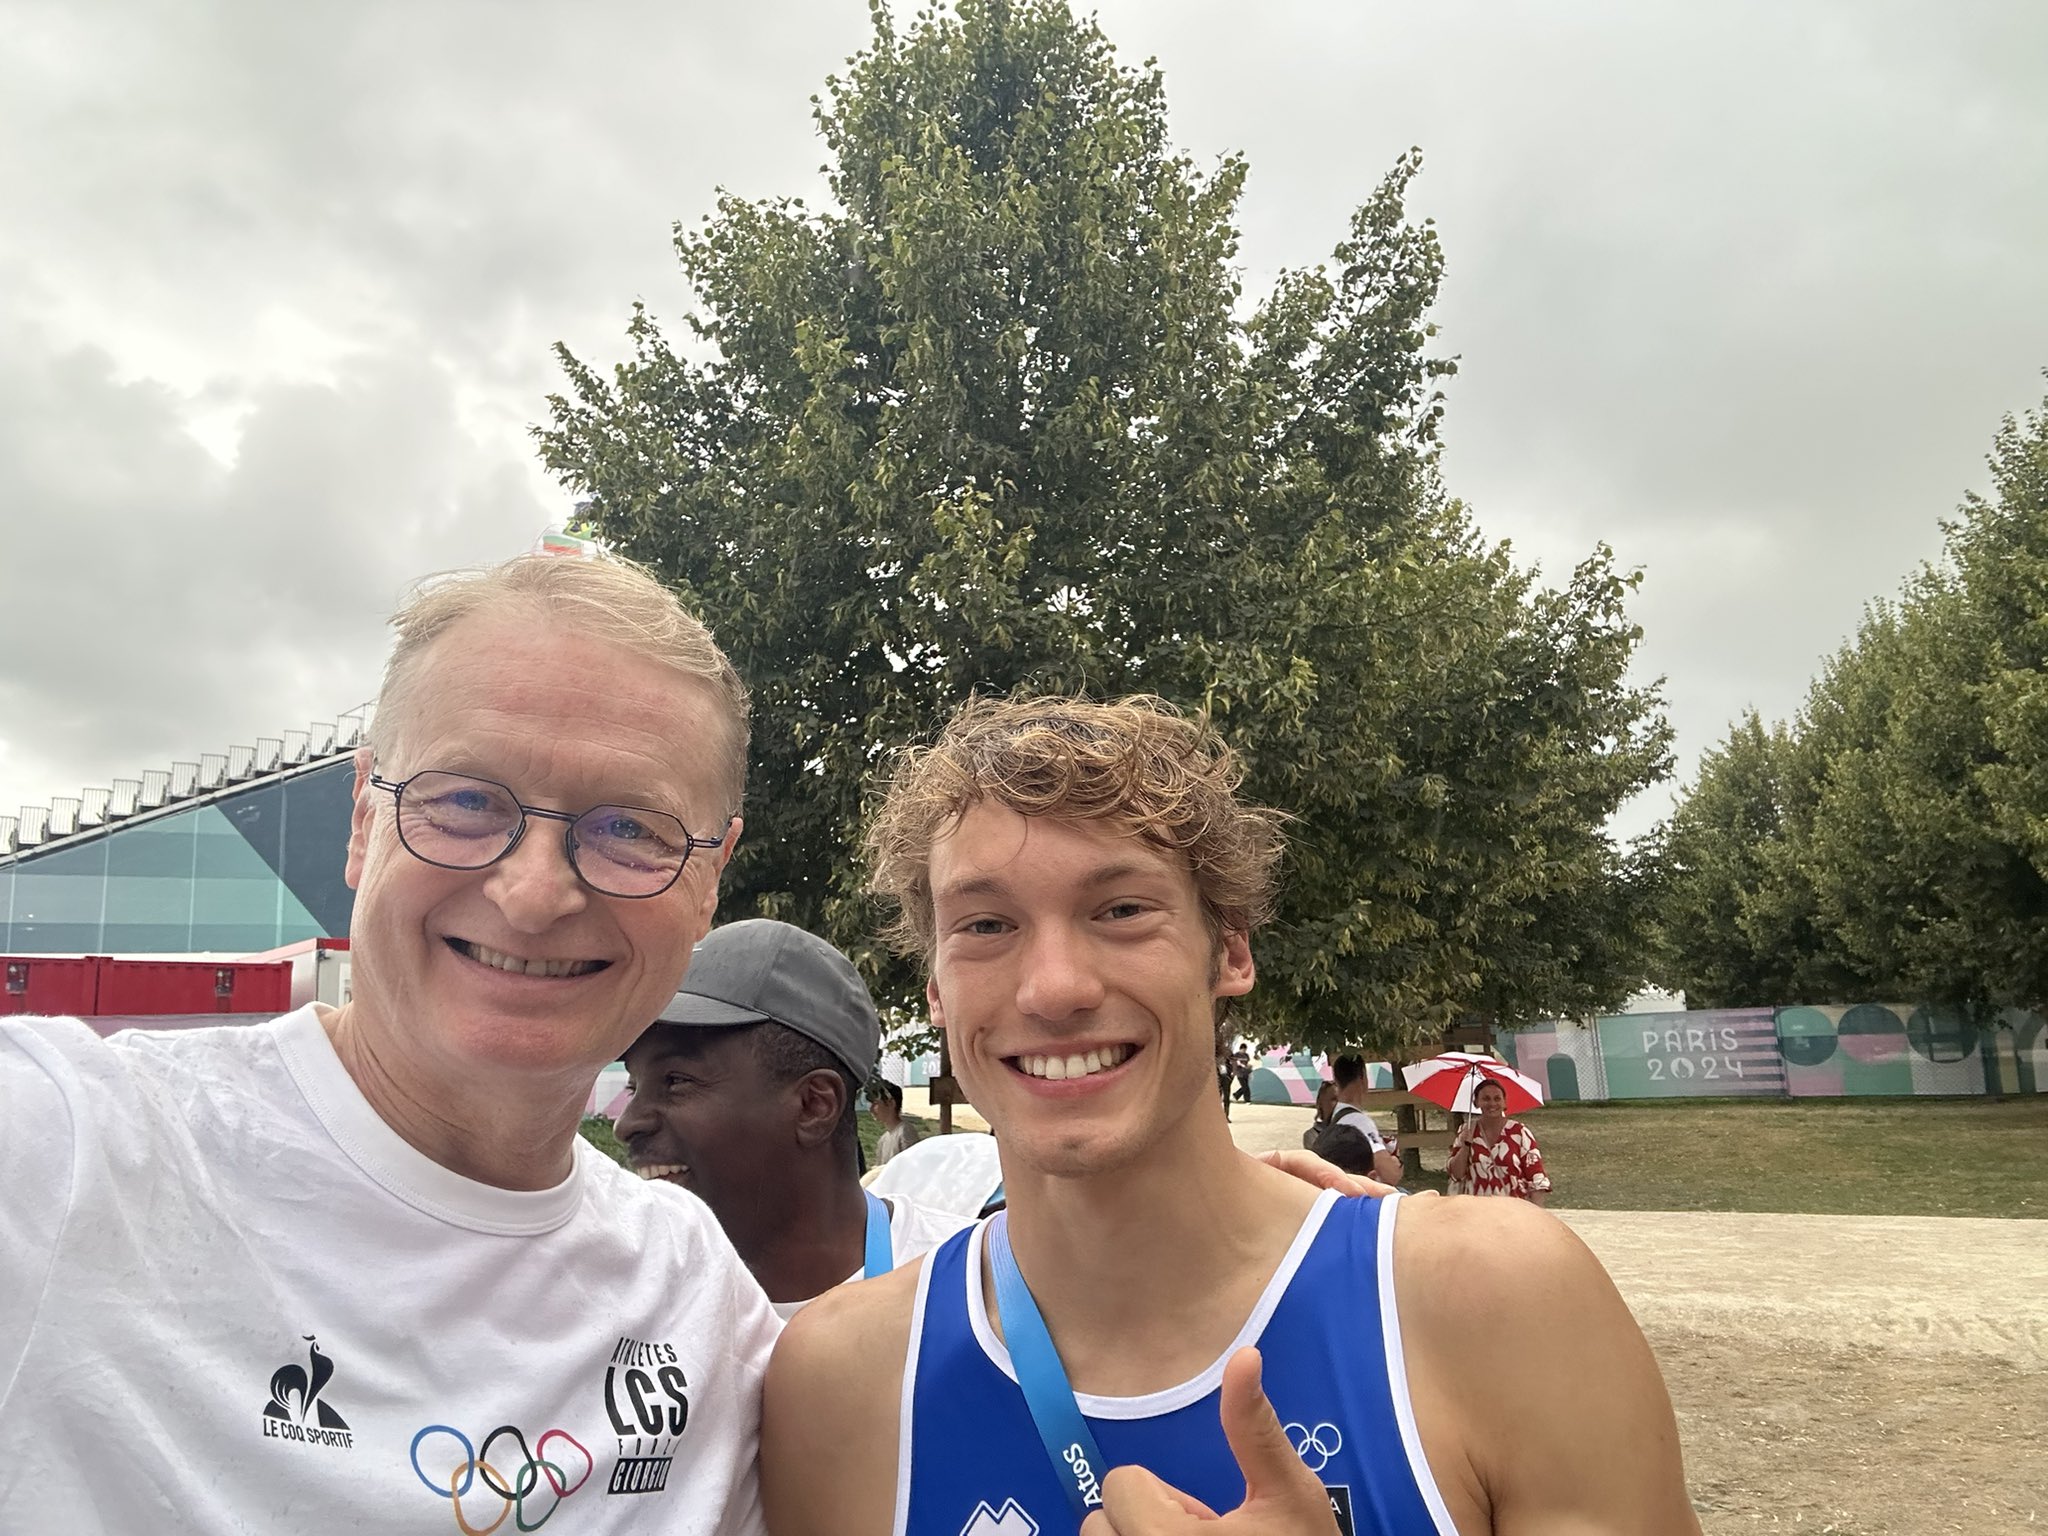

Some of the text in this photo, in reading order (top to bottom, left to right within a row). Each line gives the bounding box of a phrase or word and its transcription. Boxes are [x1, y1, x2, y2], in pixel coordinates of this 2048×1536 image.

[1647, 1056, 1744, 1081] 2024
[610, 1336, 678, 1367] ATHLETES
[604, 1366, 689, 1437] LCS
[262, 1418, 354, 1449] LE COQ SPORTIF
[611, 1459, 671, 1492] GIORGIO
[1062, 1443, 1104, 1508] Atos
